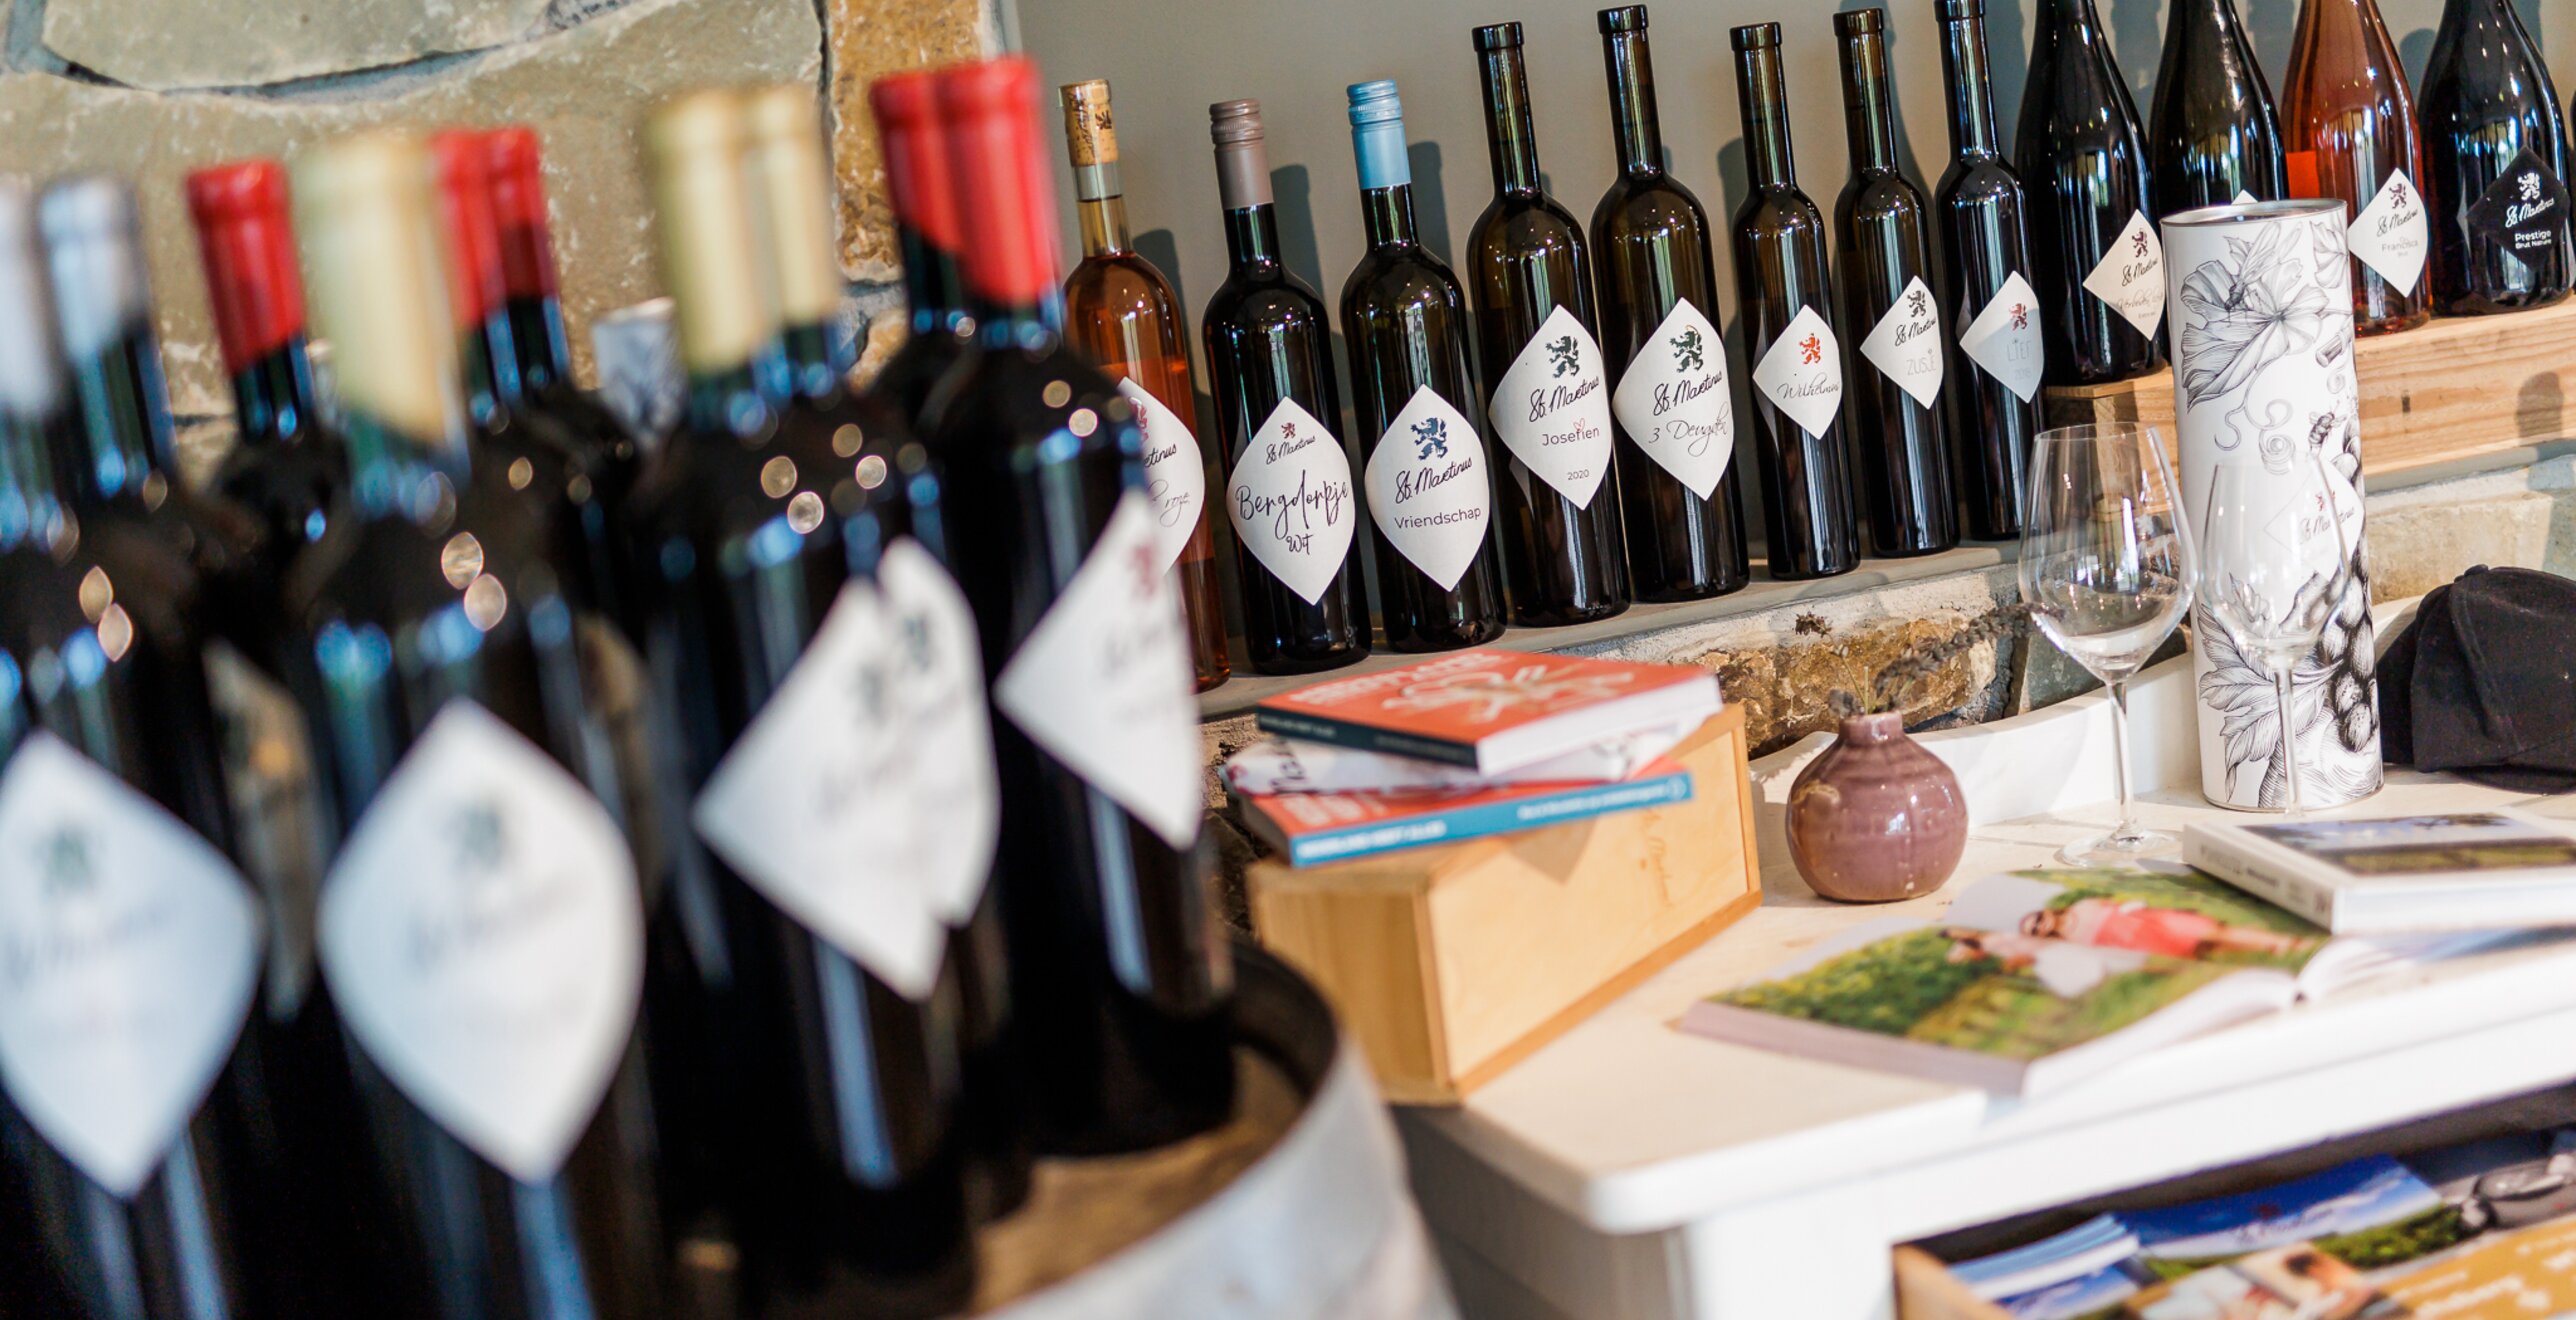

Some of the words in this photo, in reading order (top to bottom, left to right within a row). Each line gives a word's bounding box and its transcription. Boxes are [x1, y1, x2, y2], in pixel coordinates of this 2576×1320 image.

[2515, 230, 2551, 242] Prestige
[1549, 376, 1599, 412] Martinus
[1673, 371, 1722, 407] Martinus
[1541, 427, 1600, 446] Josefien
[1648, 427, 1660, 444] 3
[1279, 436, 1316, 457] Martinus
[1415, 457, 1472, 495] Martinus
[1567, 469, 1589, 480] 2020
[1395, 508, 1481, 529] Vriendschap
[1285, 533, 1314, 556] Wit
